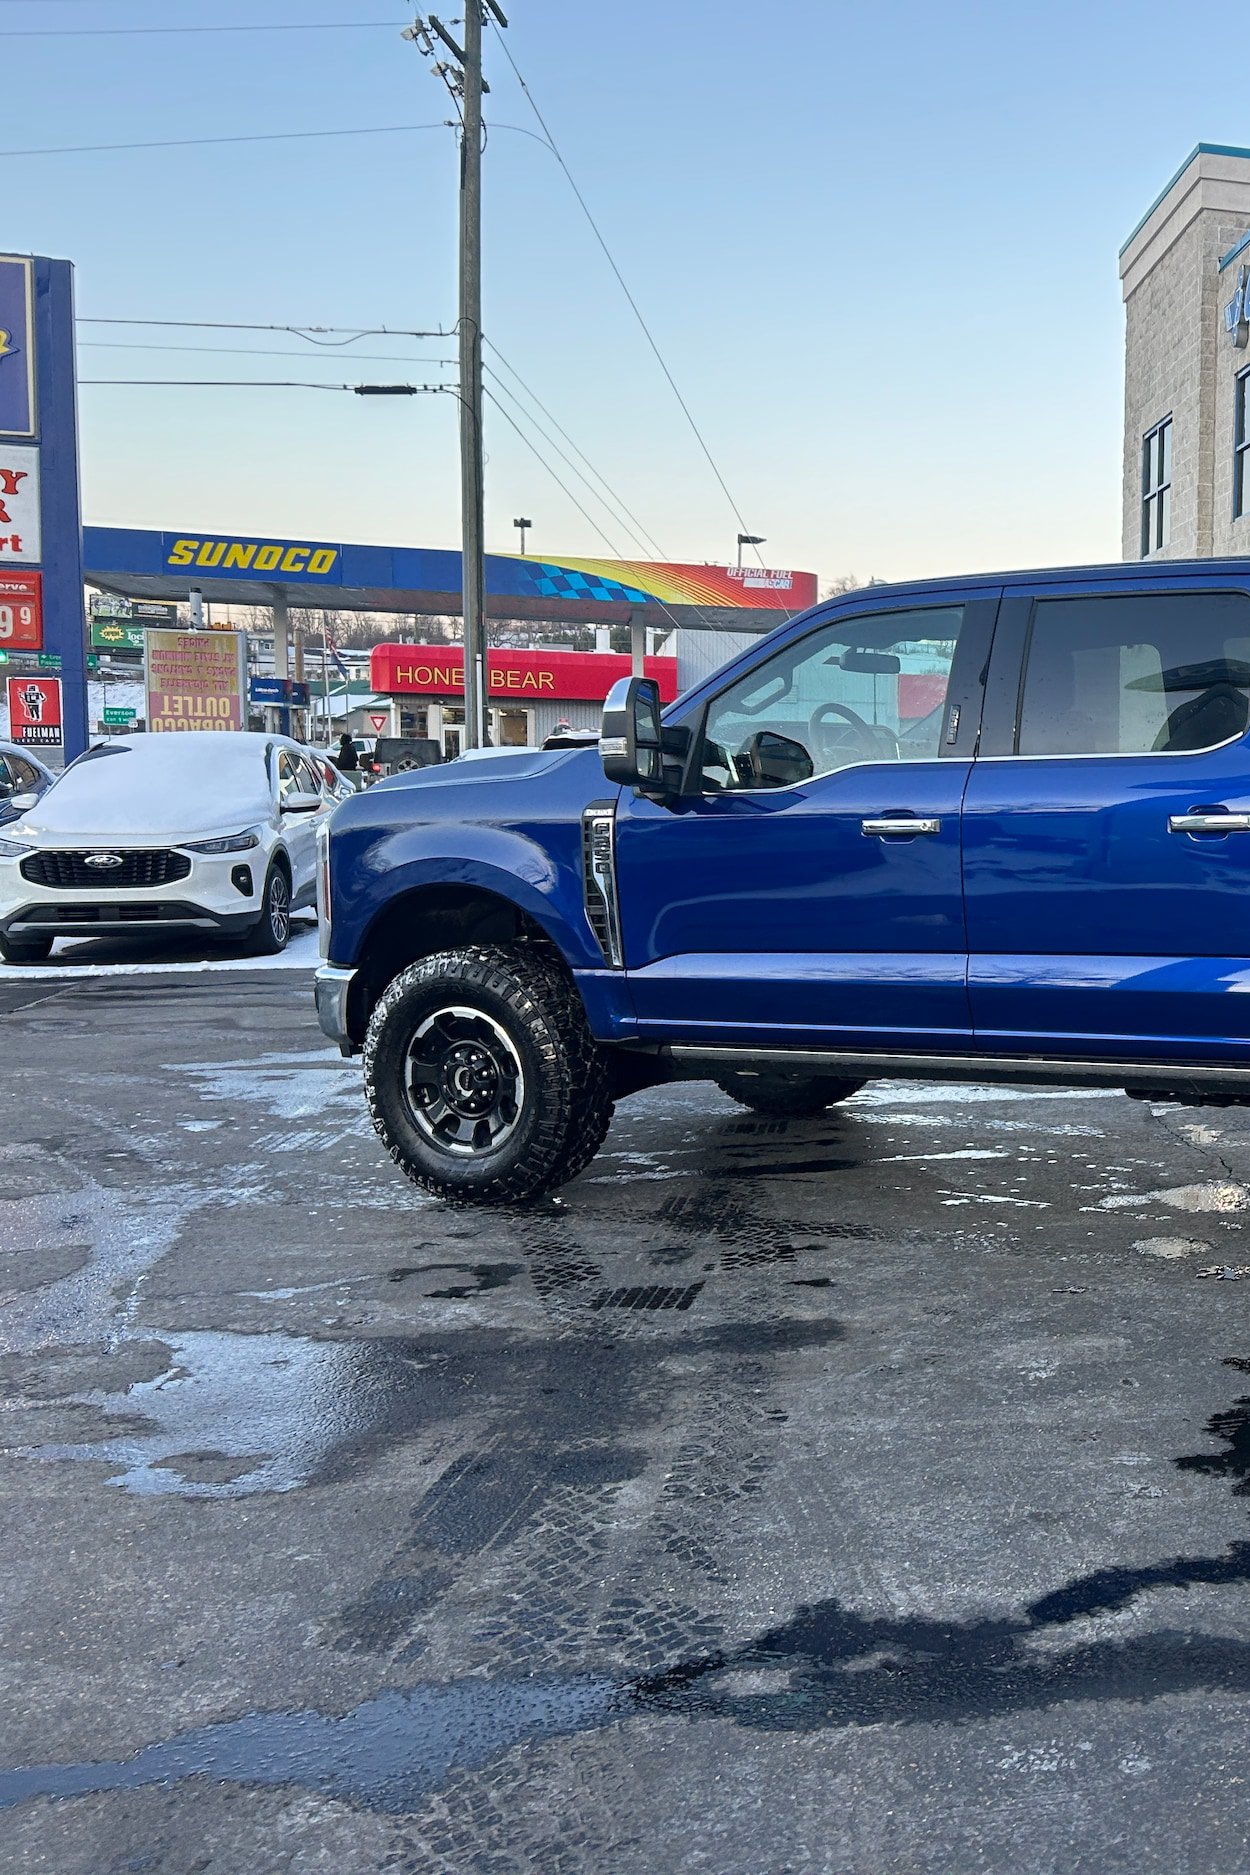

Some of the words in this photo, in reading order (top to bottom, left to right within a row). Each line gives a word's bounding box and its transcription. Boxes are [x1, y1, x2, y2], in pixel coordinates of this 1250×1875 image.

[167, 539, 338, 574] SUNOCO
[726, 567, 769, 578] OFFICIAL
[770, 570, 794, 580] FUEL
[20, 606, 32, 625] 9
[396, 665, 465, 686] HONE
[490, 669, 555, 690] BEAR
[105, 709, 135, 717] Everson
[160, 695, 231, 718] OUTLET
[22, 727, 60, 738] FUELMAN
[151, 717, 235, 732] TOBACCO
